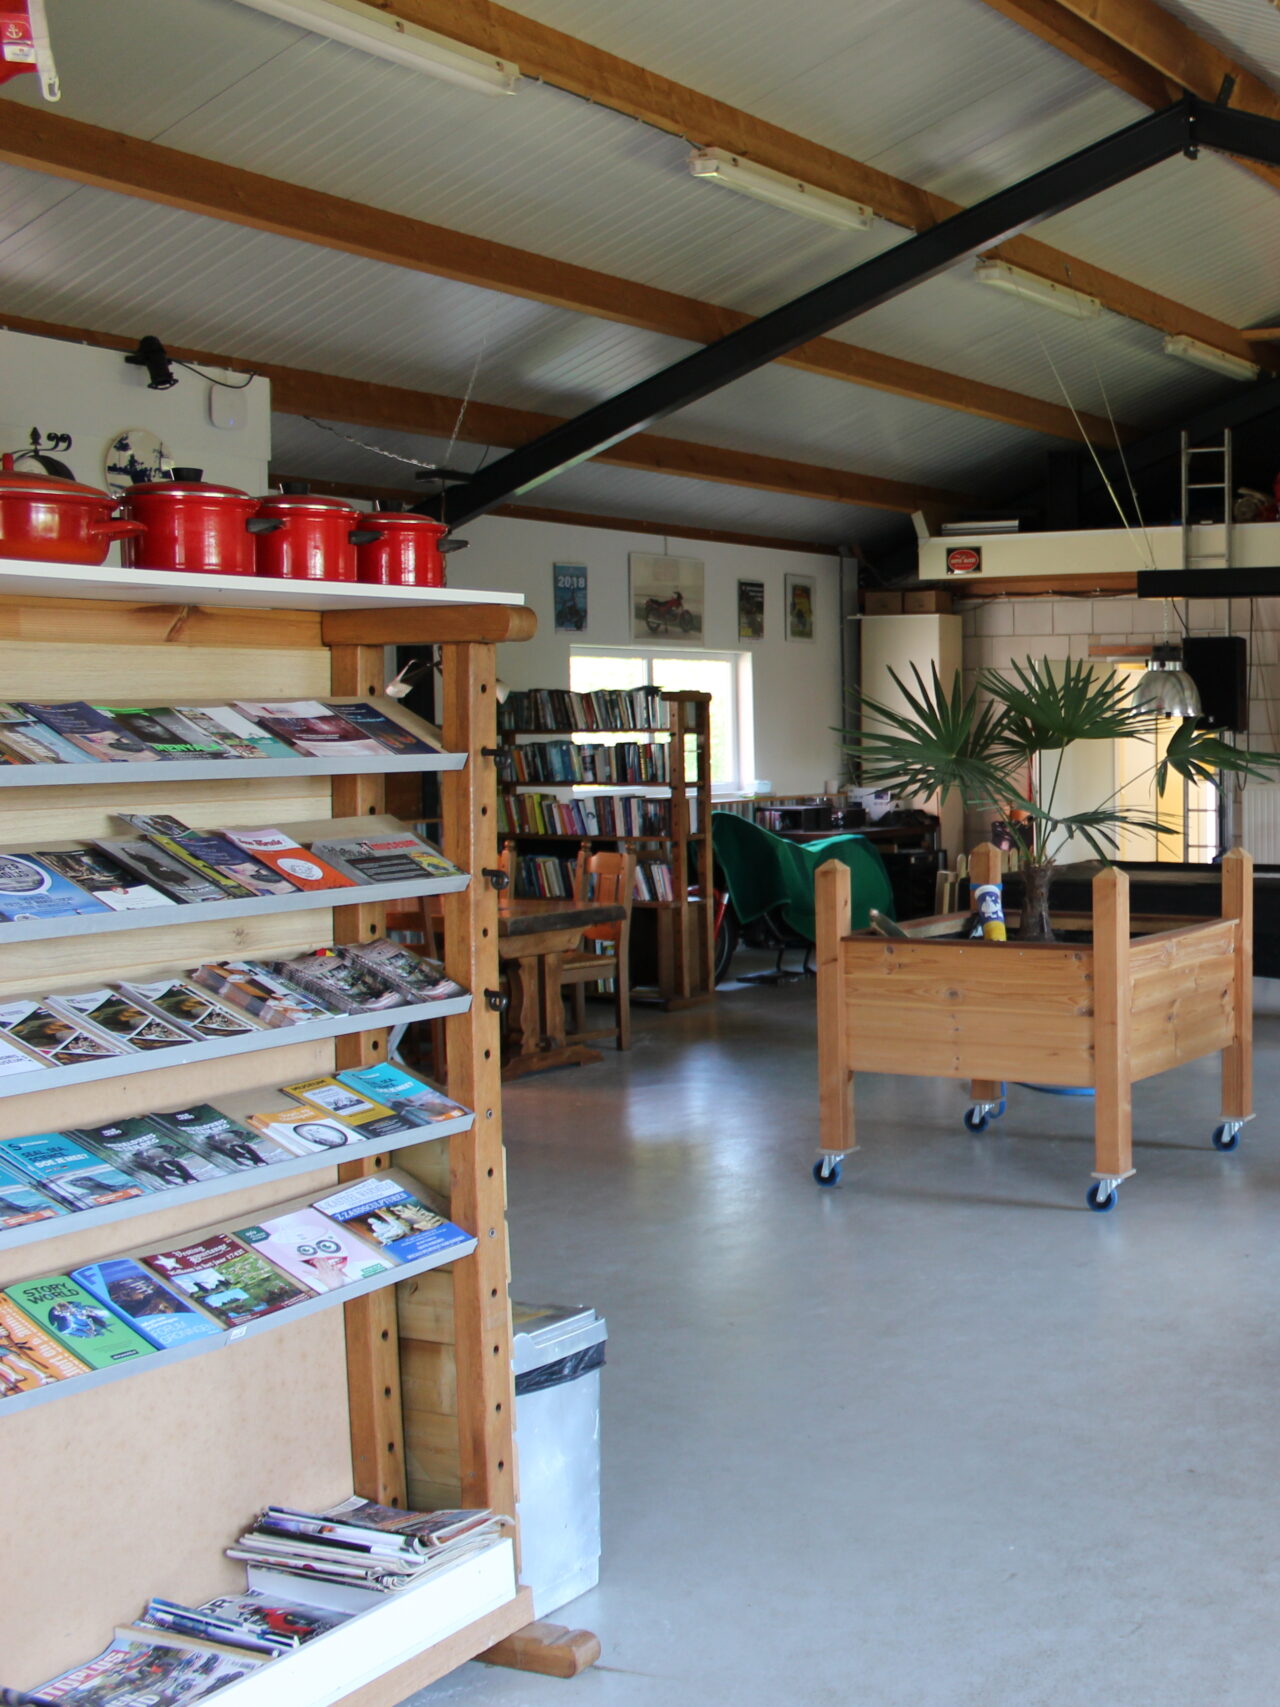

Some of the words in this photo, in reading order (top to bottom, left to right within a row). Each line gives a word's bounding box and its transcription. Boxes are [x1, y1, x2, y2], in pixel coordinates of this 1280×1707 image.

[557, 575, 586, 588] 2018
[23, 1282, 68, 1298] STORY
[27, 1288, 80, 1305] WORLD
